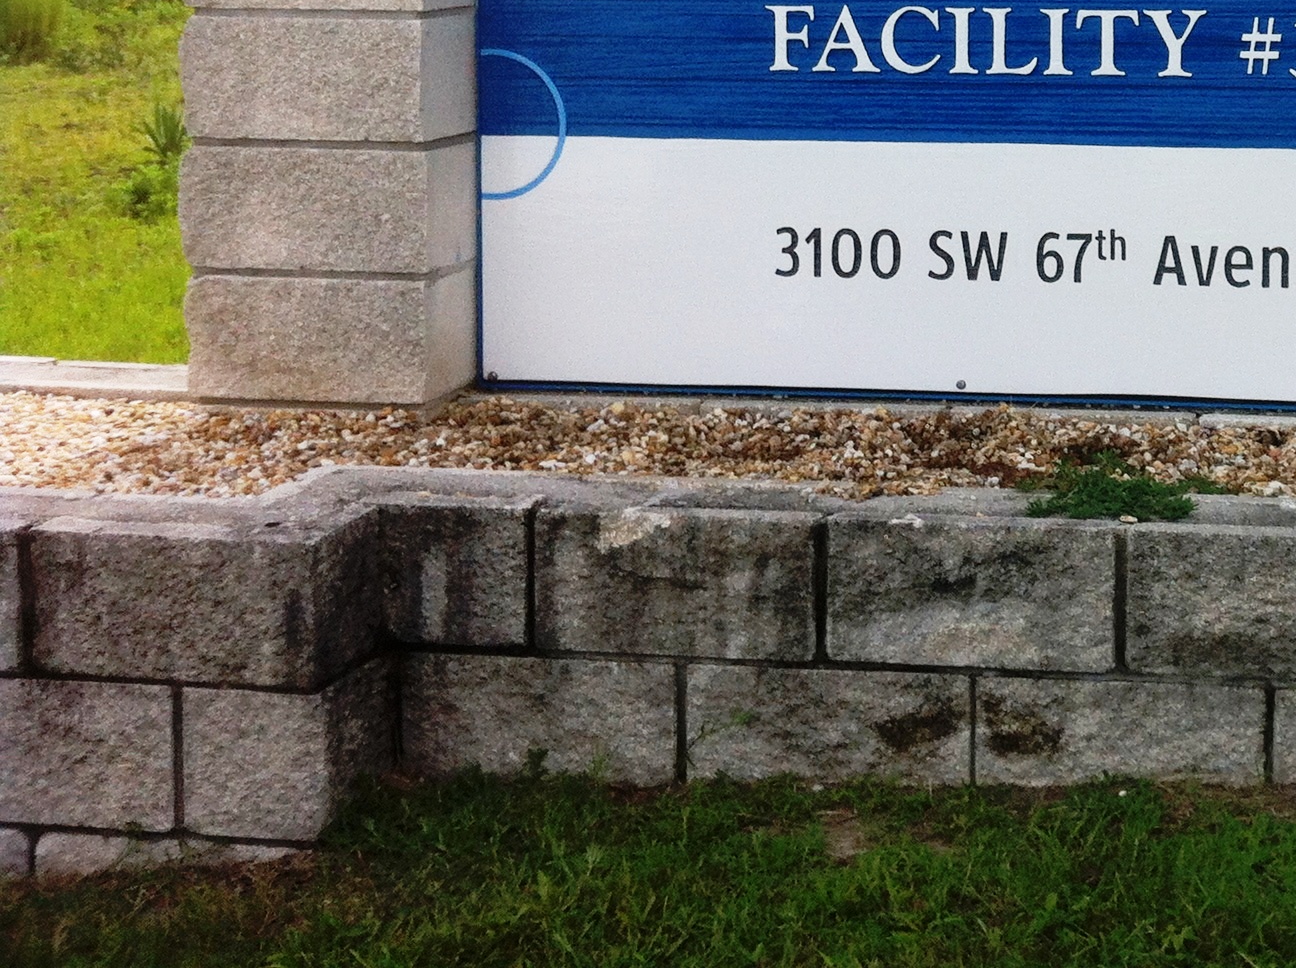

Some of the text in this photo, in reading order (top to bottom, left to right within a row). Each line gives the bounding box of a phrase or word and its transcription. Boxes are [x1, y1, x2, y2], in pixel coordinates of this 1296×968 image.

[765, 4, 1208, 79] FACILITY
[774, 226, 902, 280] 3100
[927, 229, 1008, 282] SW
[1035, 228, 1127, 284] 67th
